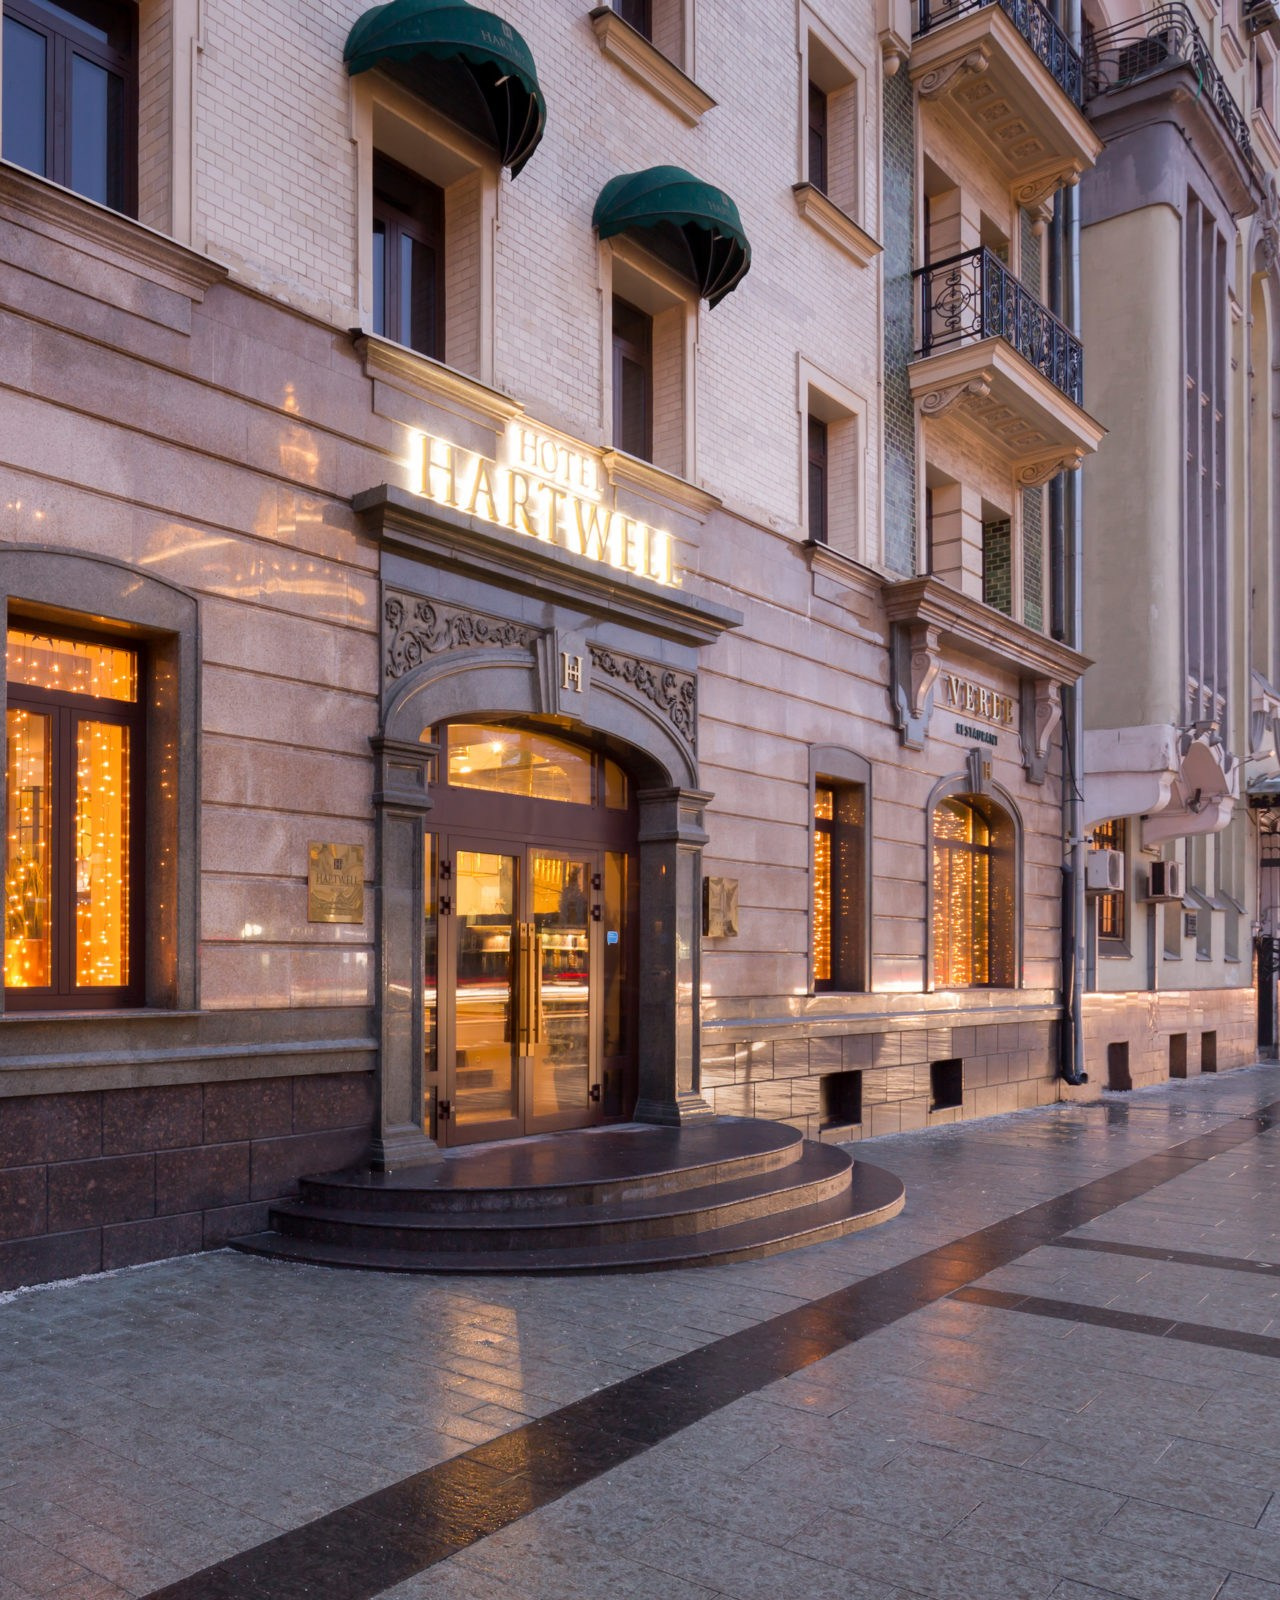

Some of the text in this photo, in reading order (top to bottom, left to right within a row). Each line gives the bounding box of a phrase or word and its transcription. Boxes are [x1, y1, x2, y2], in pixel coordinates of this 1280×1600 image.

[519, 427, 604, 492] HOTEL
[419, 433, 682, 588] HARTWELL
[947, 675, 1013, 724] VERDE
[316, 872, 361, 886] HARTWELL
